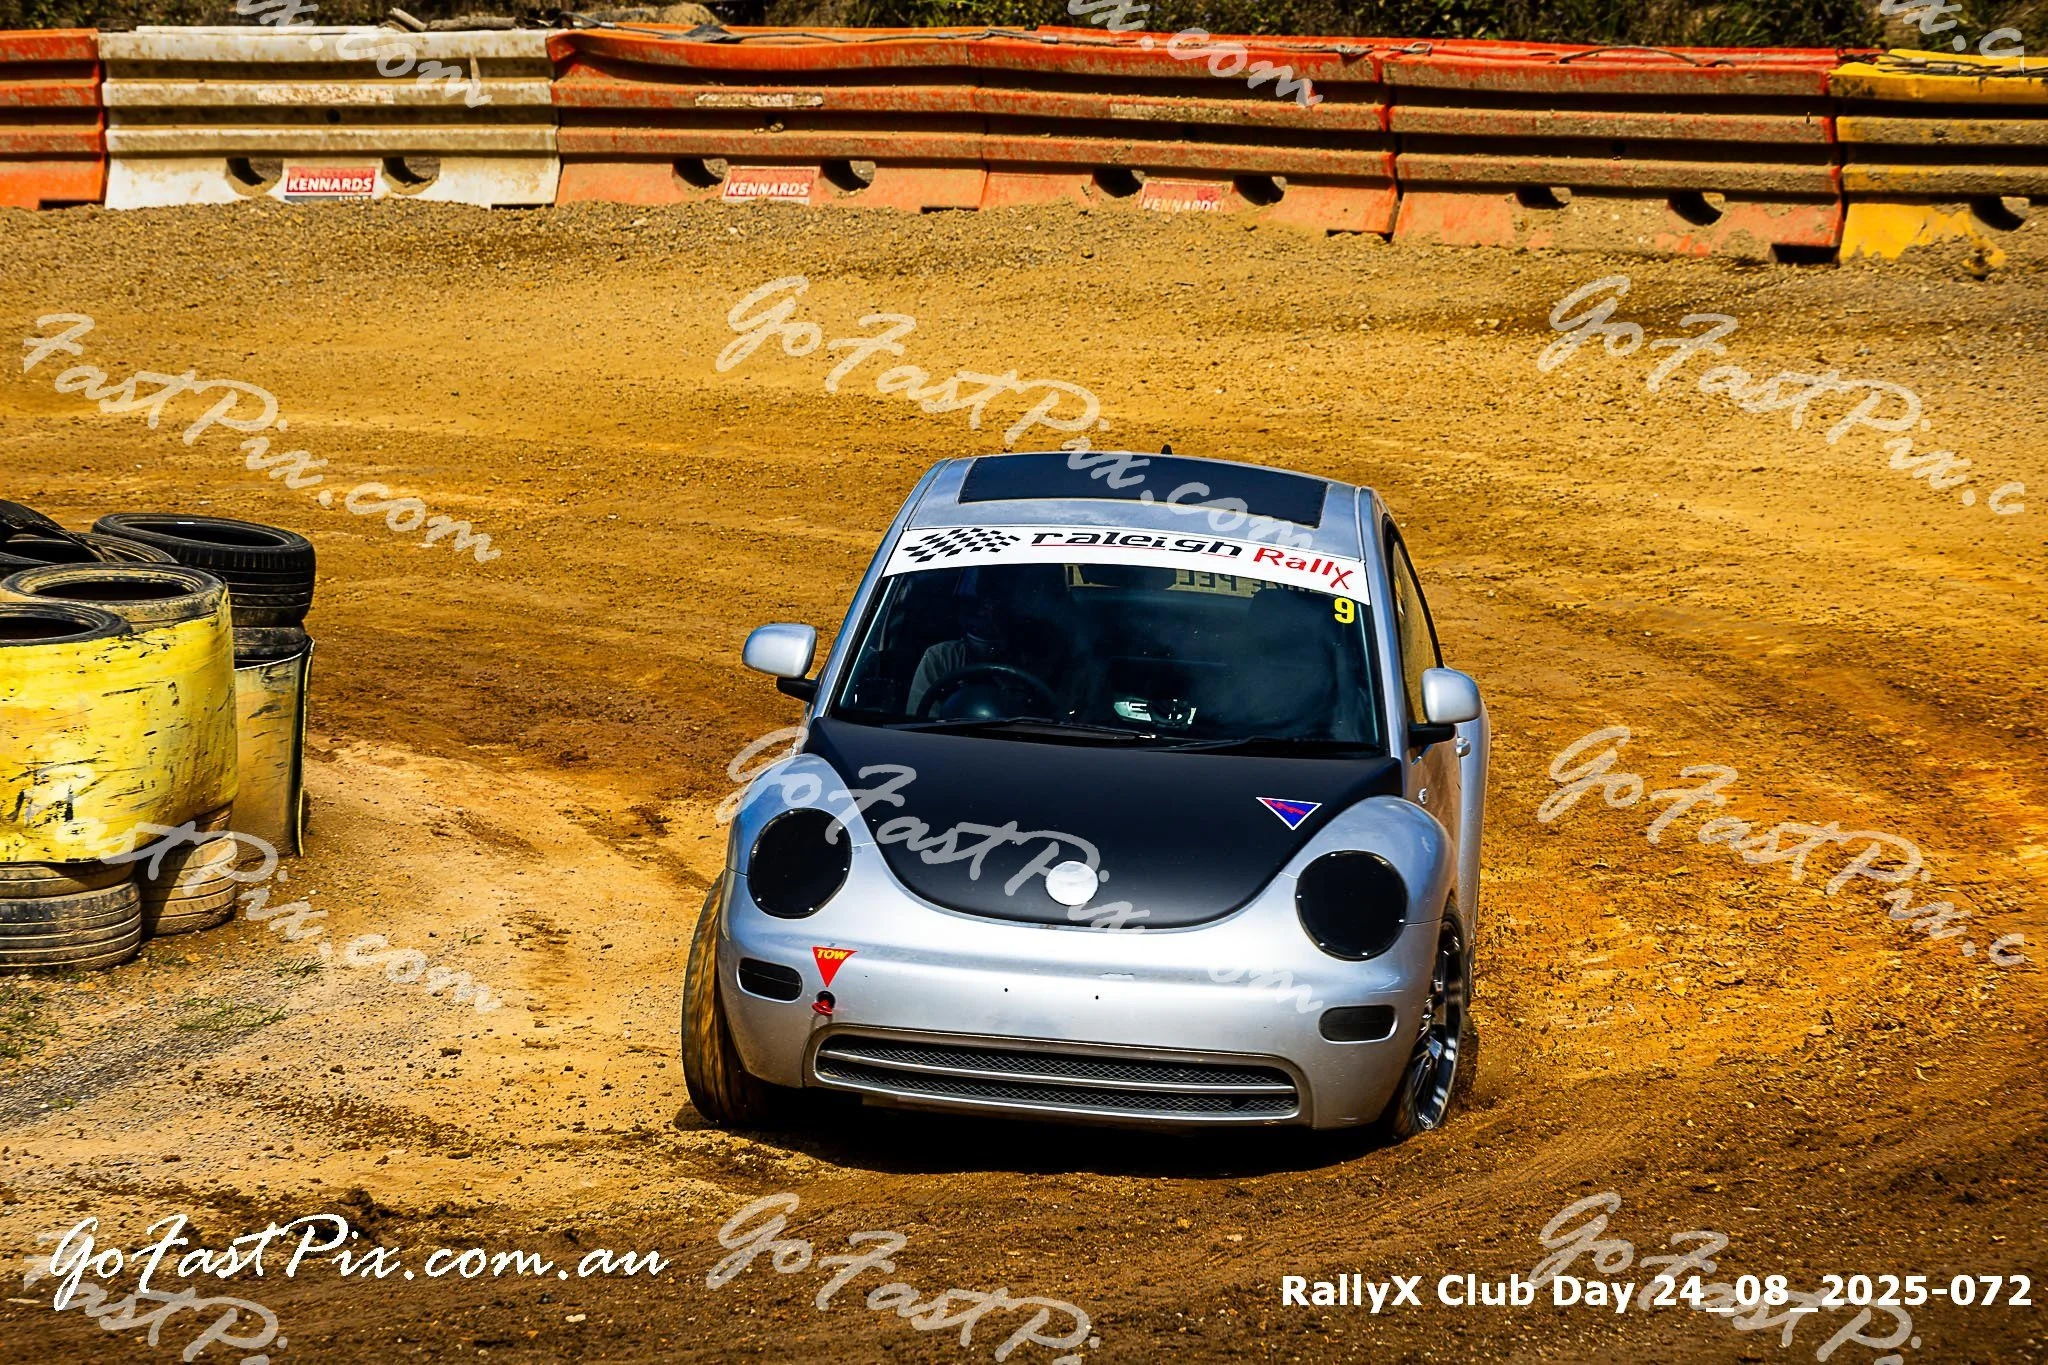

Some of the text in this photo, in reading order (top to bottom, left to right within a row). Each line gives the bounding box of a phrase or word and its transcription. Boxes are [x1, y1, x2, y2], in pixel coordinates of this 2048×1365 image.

[288, 177, 373, 192] KENNARDS
[727, 181, 810, 196] KENNARDS
[1031, 531, 1244, 557] raleigh
[1333, 597, 1355, 624] 9
[817, 949, 849, 960] TOW
